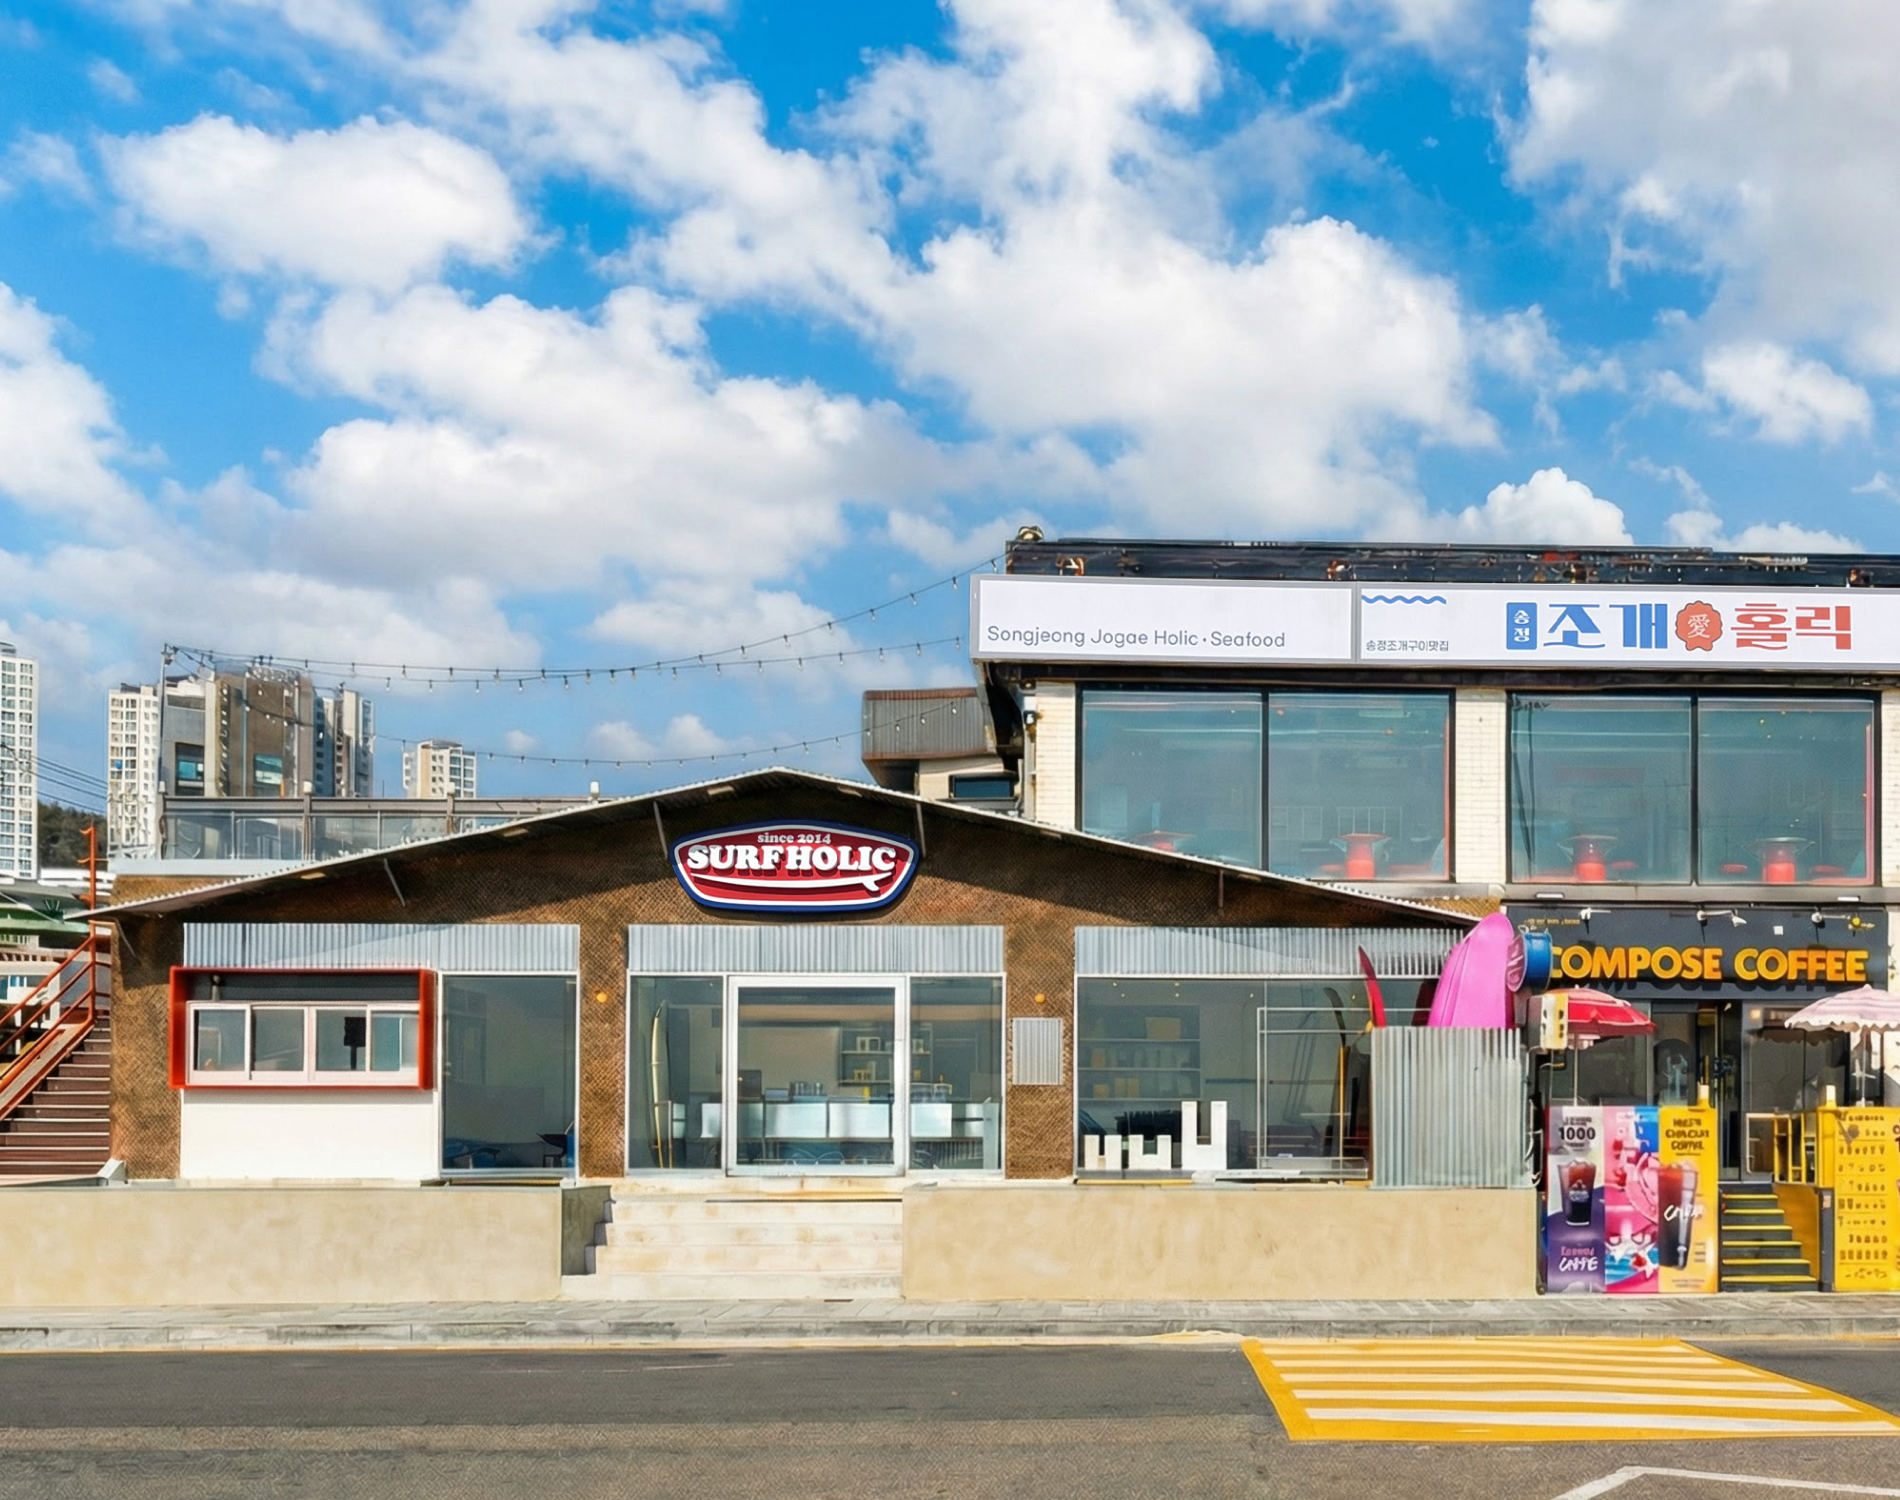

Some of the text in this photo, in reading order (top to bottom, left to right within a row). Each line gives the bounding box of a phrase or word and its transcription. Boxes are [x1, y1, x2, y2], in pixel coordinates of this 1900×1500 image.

[987, 625, 1086, 647] Songjeong
[1090, 628, 1149, 648] Jogae
[1513, 609, 1531, 643] 송정
[1543, 602, 1852, 650] 조개 愛 홀릭
[757, 832, 832, 845] since 2014
[686, 844, 897, 872] SURFHOLIC
[1734, 946, 1870, 982] COFFEE
[1558, 1126, 1596, 1141] 1000
